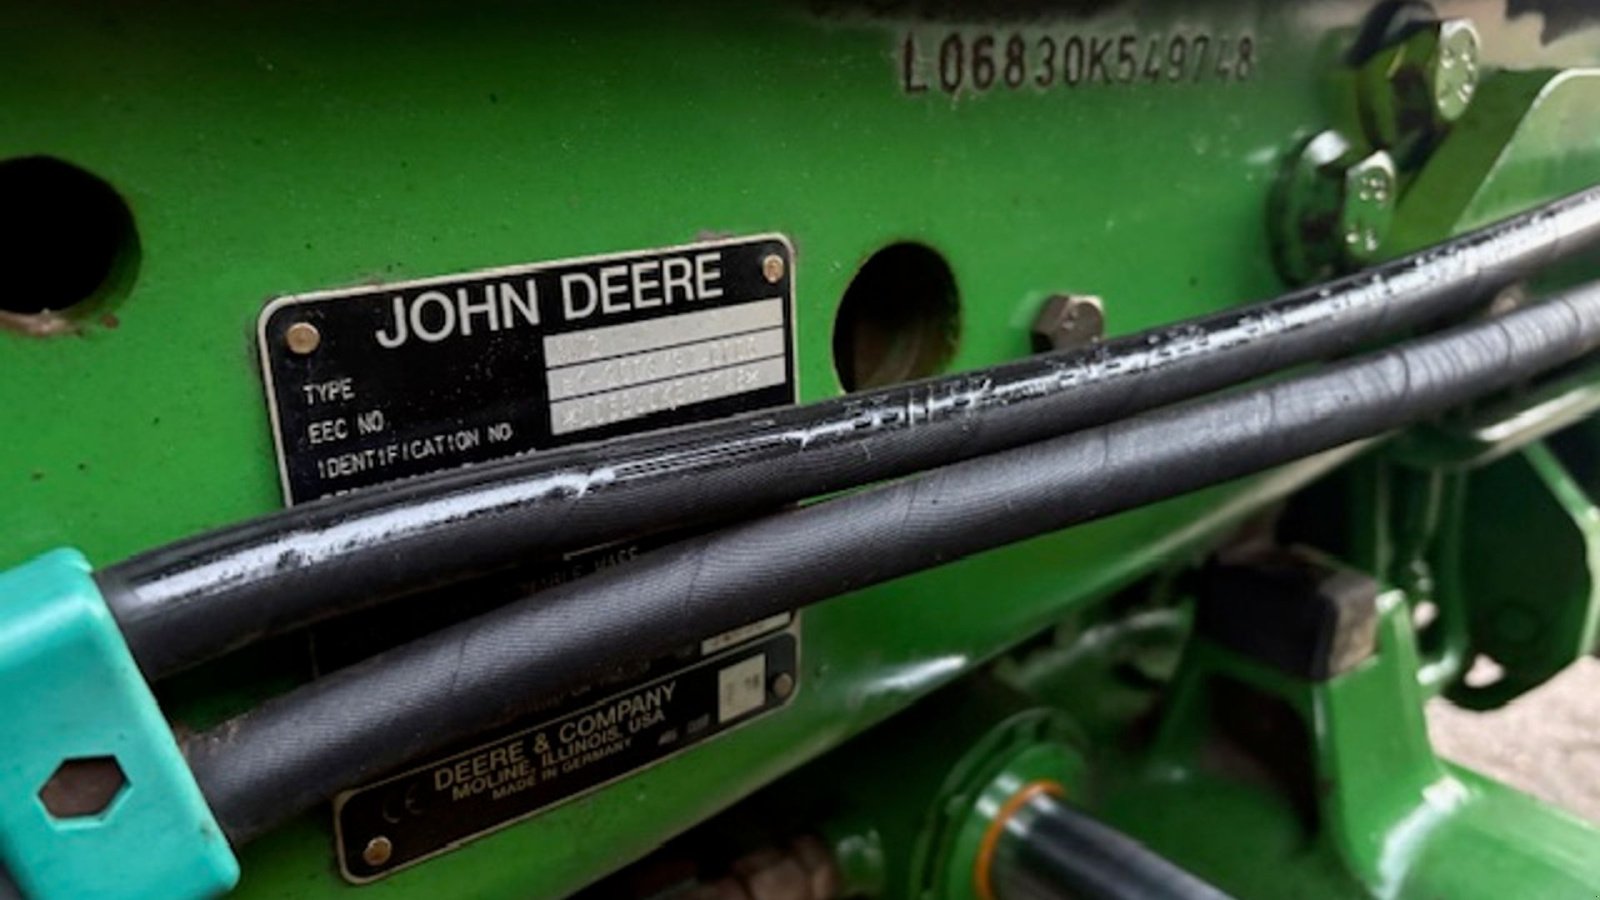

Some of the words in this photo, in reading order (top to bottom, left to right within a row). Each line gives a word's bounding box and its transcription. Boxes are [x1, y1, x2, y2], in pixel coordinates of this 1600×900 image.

[376, 279, 541, 349] JOHN
[561, 252, 724, 320] DEERE
[303, 378, 355, 405] TYPE
[308, 418, 347, 444] EEC
[317, 428, 480, 479] IDENTIFICATION
[488, 422, 513, 444] NO
[433, 739, 525, 791] DEERE
[533, 731, 551, 753] &
[559, 681, 677, 744] COMPANY
[628, 709, 666, 735] USA
[492, 776, 537, 801] MADE
[541, 767, 559, 783] IN
[563, 739, 633, 774] GERMANY
